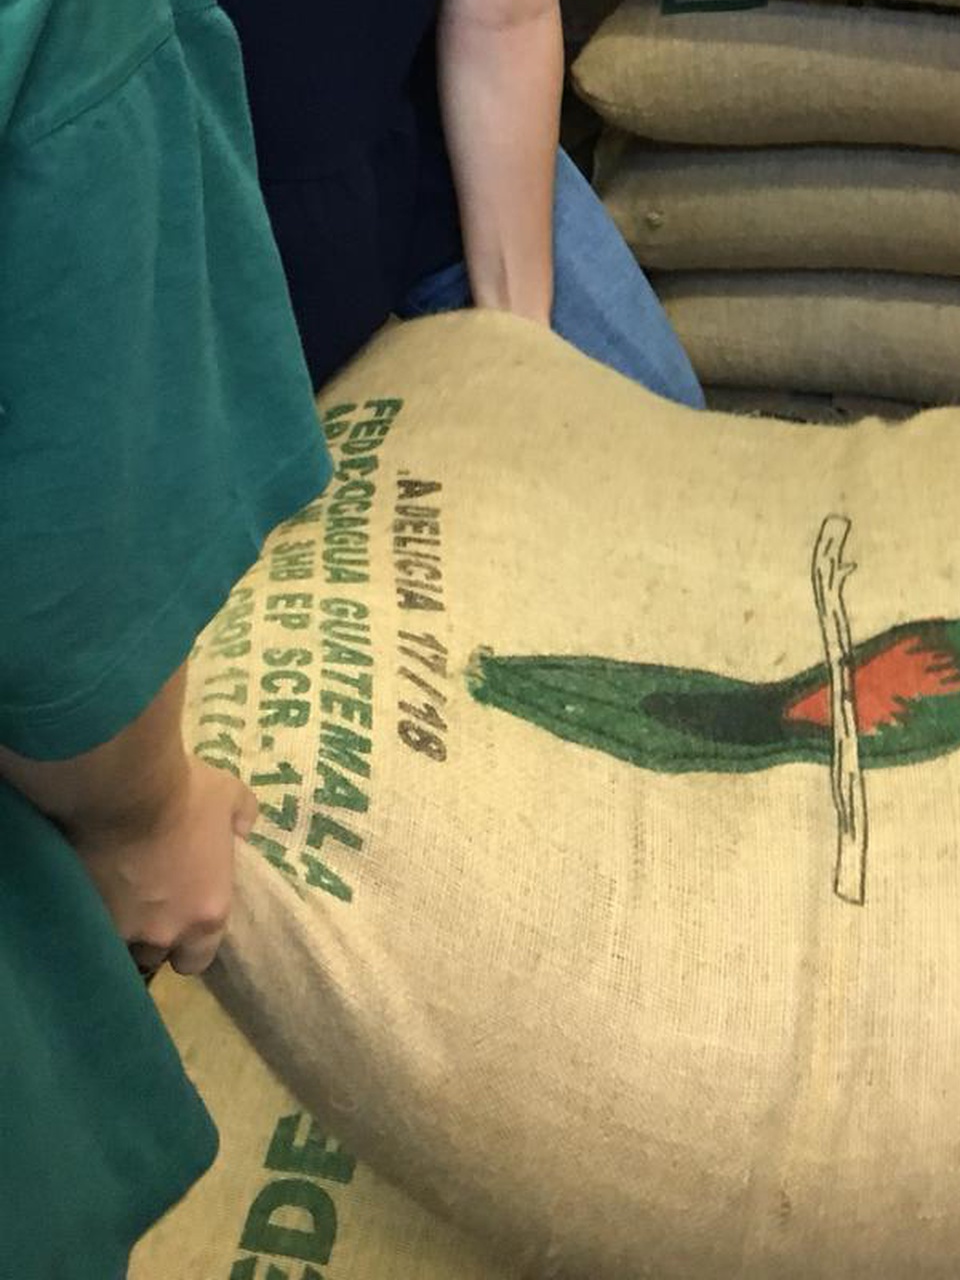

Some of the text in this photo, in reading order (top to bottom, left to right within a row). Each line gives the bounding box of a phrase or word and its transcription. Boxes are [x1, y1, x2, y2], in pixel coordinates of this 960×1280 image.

[263, 593, 314, 629] EP
[392, 504, 446, 611] DELICIA
[300, 596, 375, 903] GUATEMALA
[397, 629, 449, 762] 17/18
